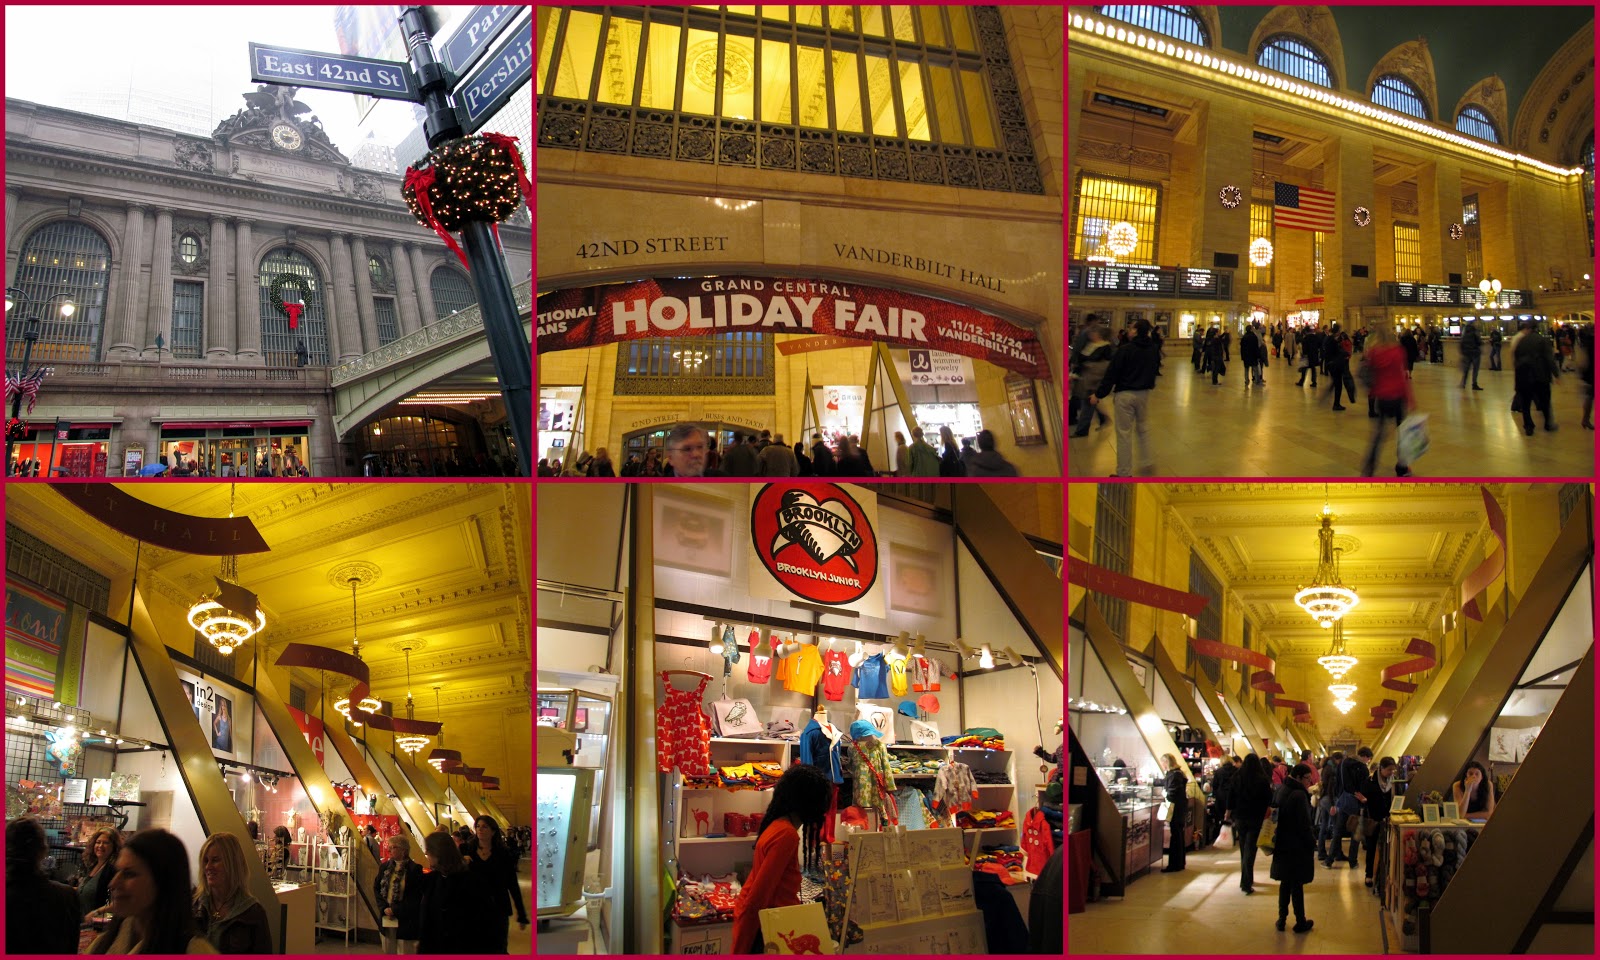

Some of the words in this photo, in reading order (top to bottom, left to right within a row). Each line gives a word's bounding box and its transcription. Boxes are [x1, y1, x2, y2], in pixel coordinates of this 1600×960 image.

[264, 55, 315, 77] East
[320, 63, 373, 84] 42nd
[377, 70, 401, 87] St
[576, 239, 640, 259] 42ND
[645, 236, 729, 254] STREET
[833, 243, 956, 279] VANDERBILT
[960, 268, 1006, 294] HALL
[701, 279, 765, 292] GRAND
[773, 280, 851, 298] CENTRAL
[612, 293, 823, 336] HOLIDAY
[834, 299, 929, 343] FAIR
[937, 326, 1009, 356] VANDERBILT
[1010, 347, 1038, 366] HALL
[934, 364, 959, 373] jewelry
[631, 418, 651, 428] 42ND
[653, 413, 680, 423] STREET
[726, 415, 743, 423] AND
[745, 418, 764, 429] TAXIS
[153, 519, 242, 543] HALL
[782, 507, 860, 548] BROOKLYN
[776, 562, 828, 582] BROOKLYN
[828, 573, 862, 589] JUNIOR
[196, 681, 214, 703] in2
[196, 698, 214, 713] design
